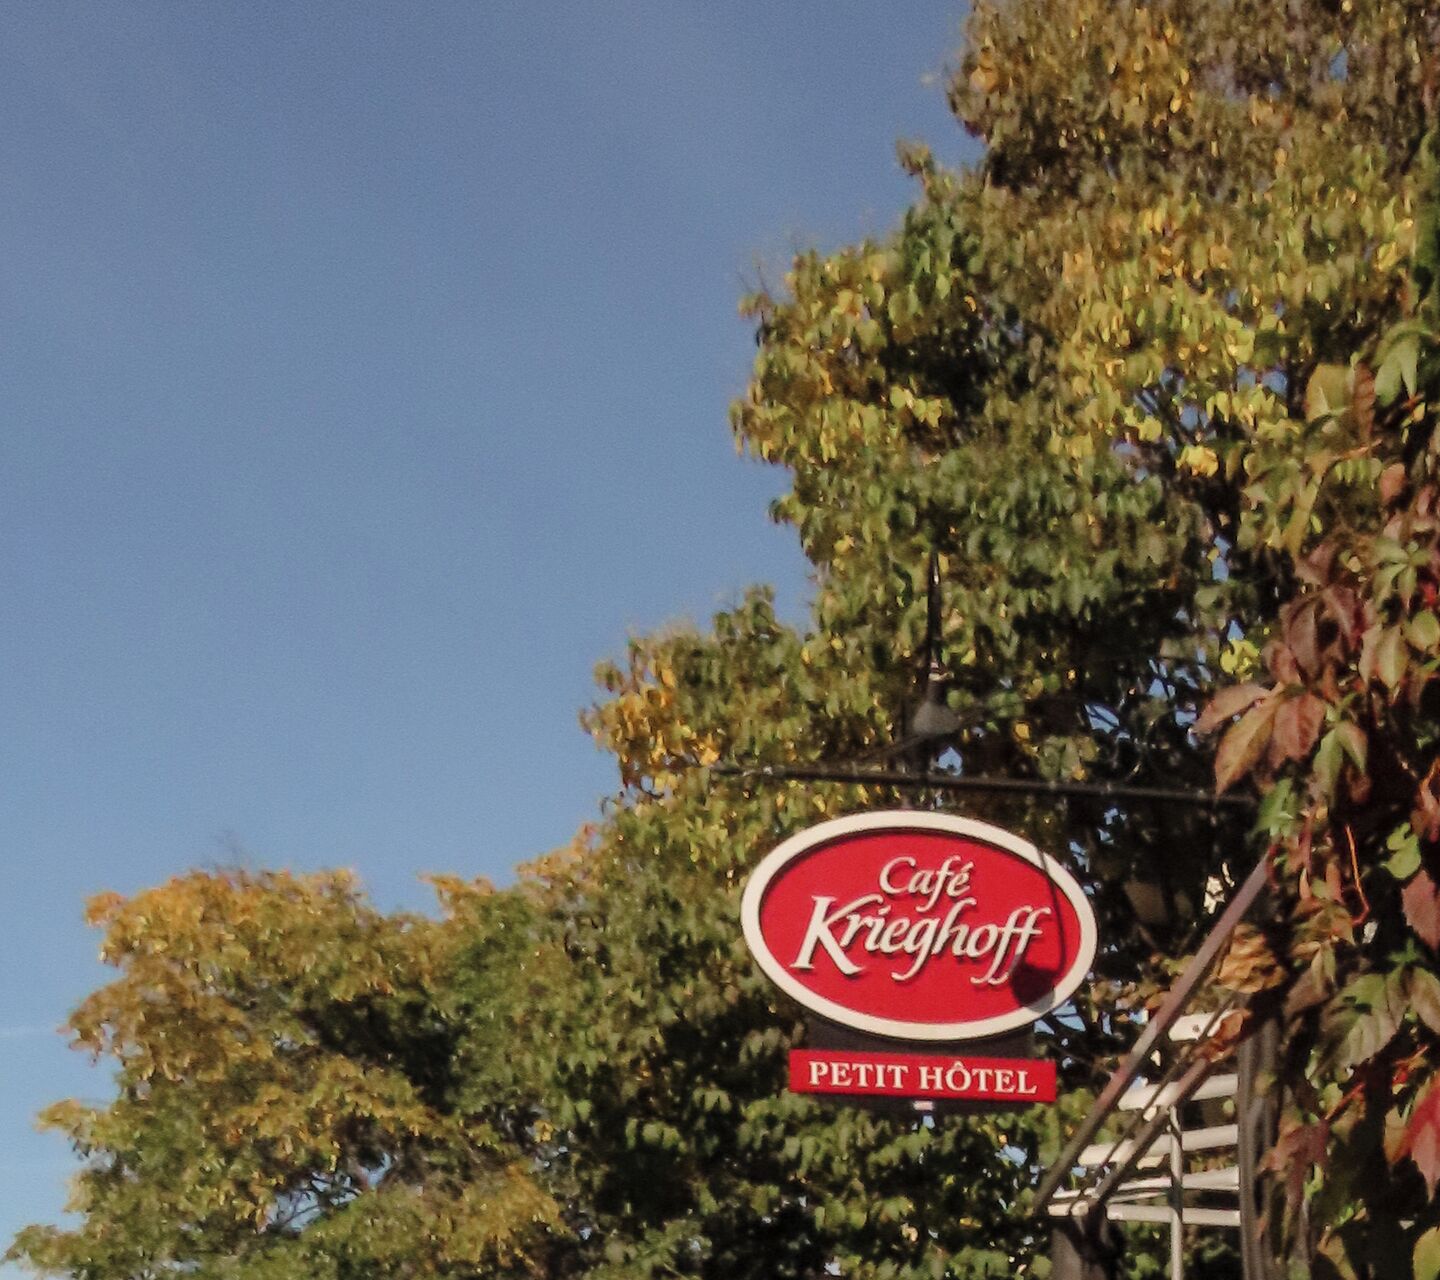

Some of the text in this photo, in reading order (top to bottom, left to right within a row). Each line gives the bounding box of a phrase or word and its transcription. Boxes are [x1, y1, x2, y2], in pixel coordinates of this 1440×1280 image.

[879, 855, 975, 912] Café
[789, 896, 1052, 985] Krieghoff
[808, 1060, 1038, 1095] PETIT HÔTEL
